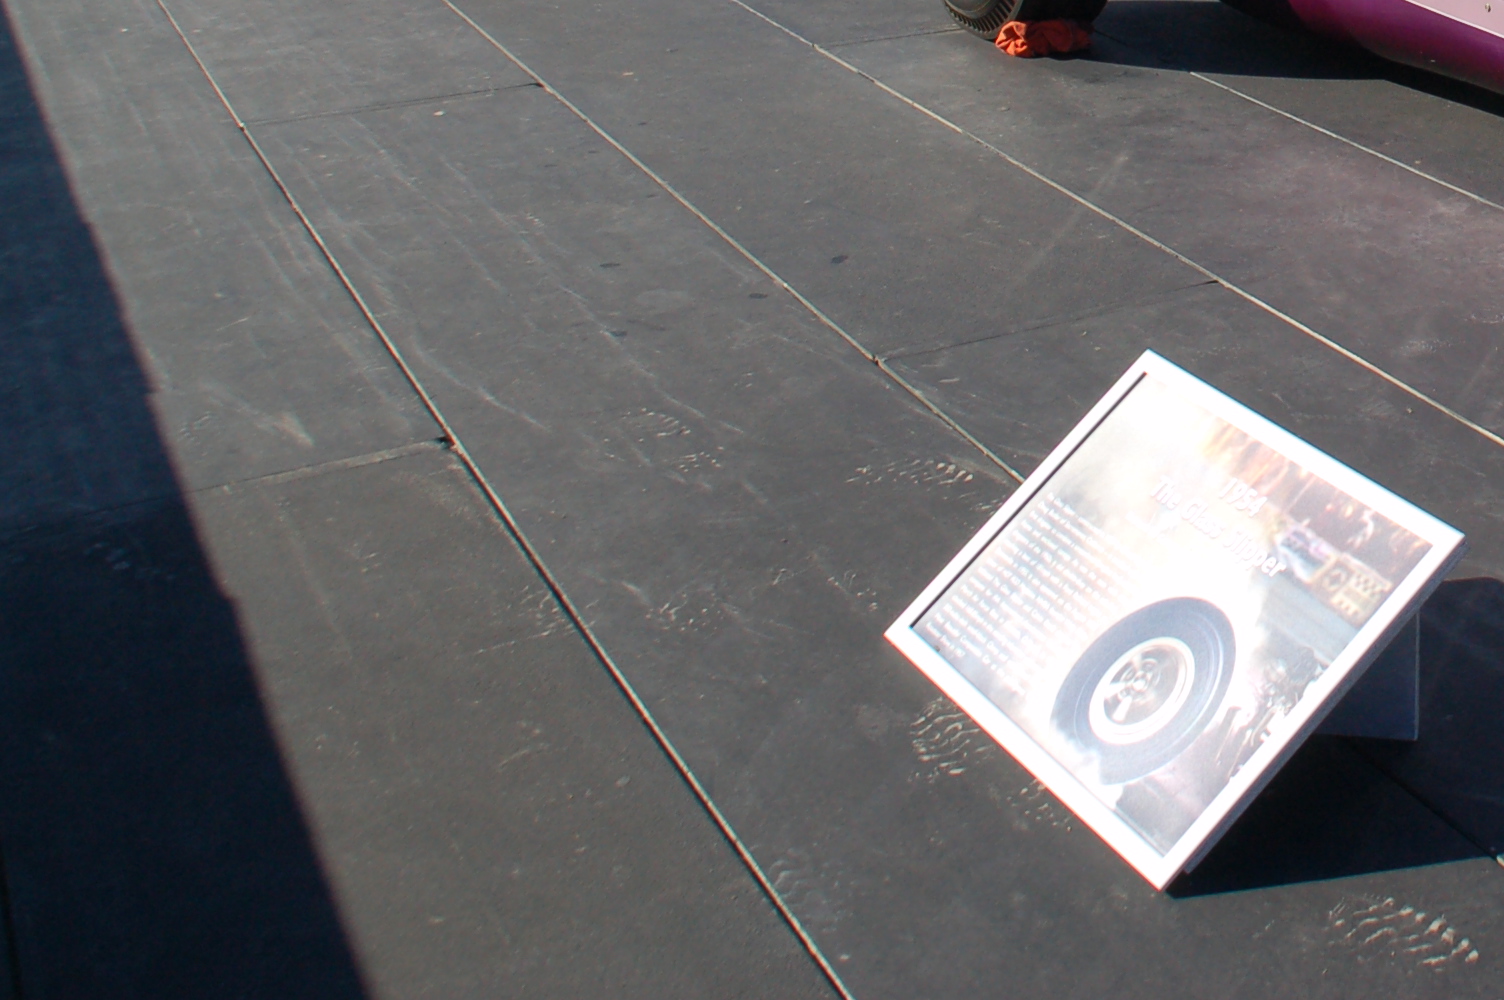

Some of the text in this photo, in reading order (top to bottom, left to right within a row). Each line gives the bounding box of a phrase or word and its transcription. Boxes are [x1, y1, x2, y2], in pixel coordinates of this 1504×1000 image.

[1149, 475, 1183, 510] The
[1179, 497, 1226, 540] Glass
[1221, 528, 1287, 579] Slipper
[1218, 477, 1268, 518] 1954
